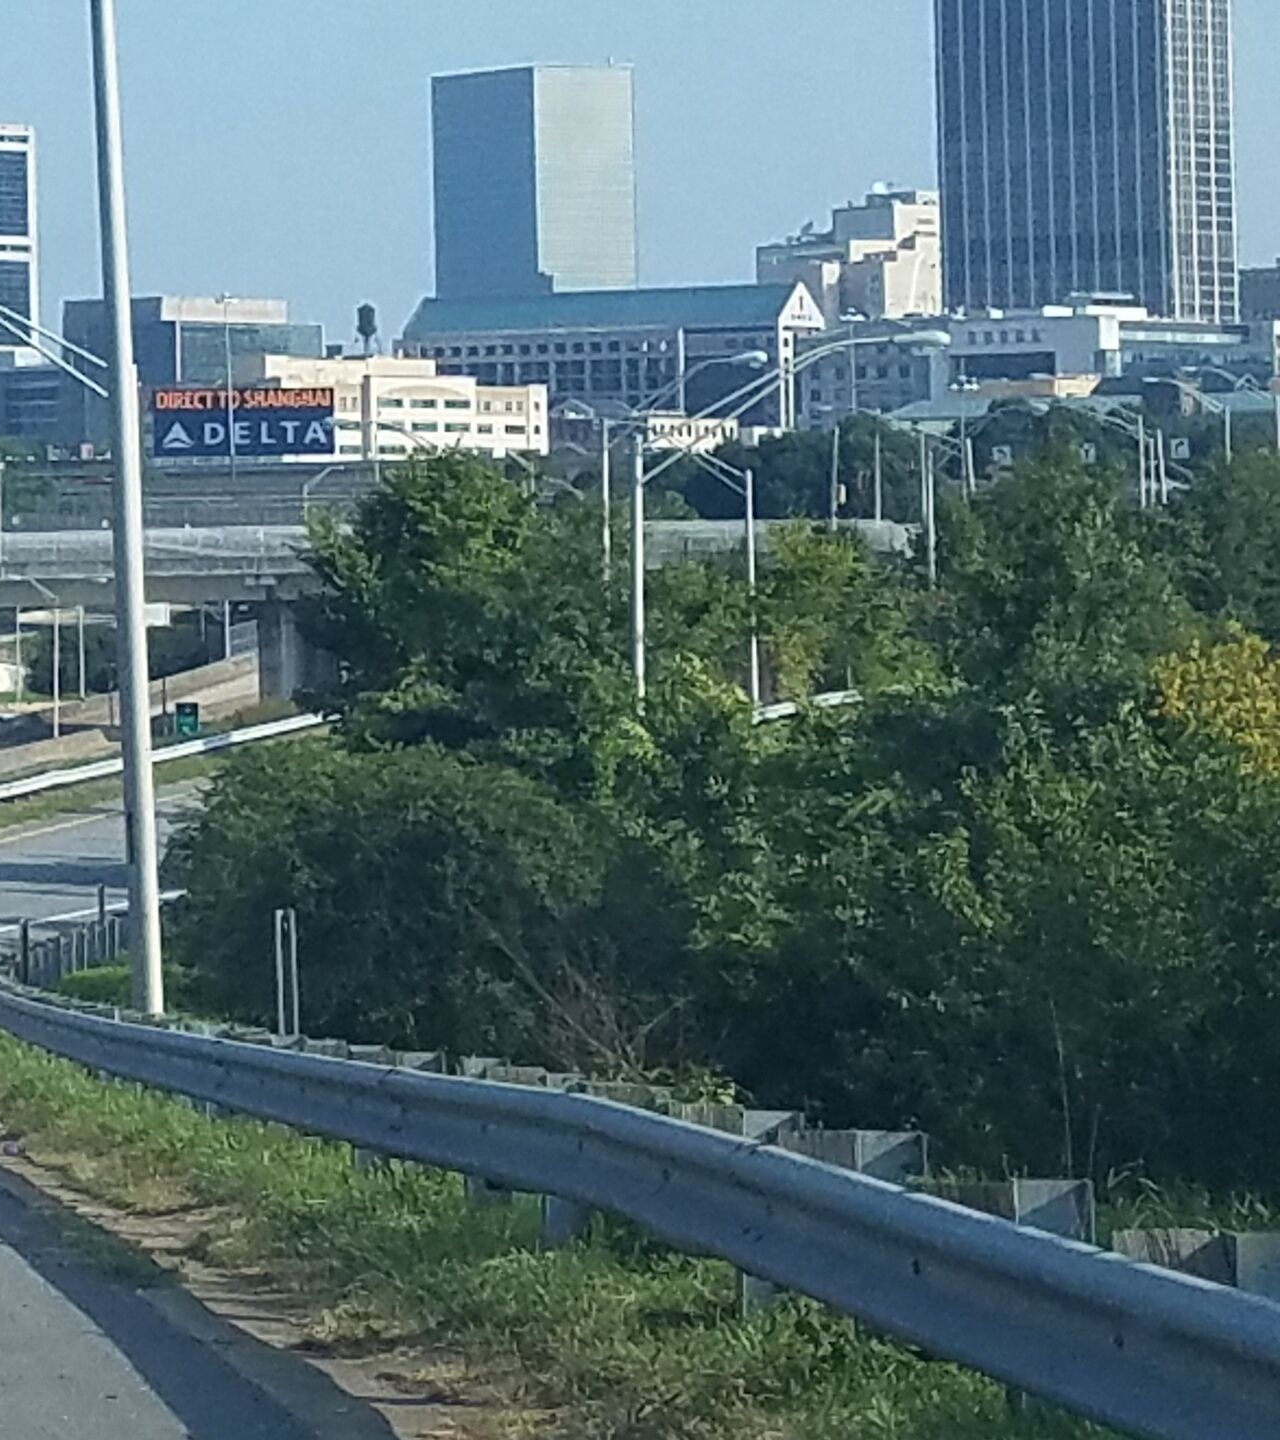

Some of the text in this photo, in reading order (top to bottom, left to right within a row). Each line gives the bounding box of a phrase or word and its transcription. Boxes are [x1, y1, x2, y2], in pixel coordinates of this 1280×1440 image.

[155, 389, 332, 409] DIRECT TO SHANGHAI
[203, 420, 328, 446] DELTA
